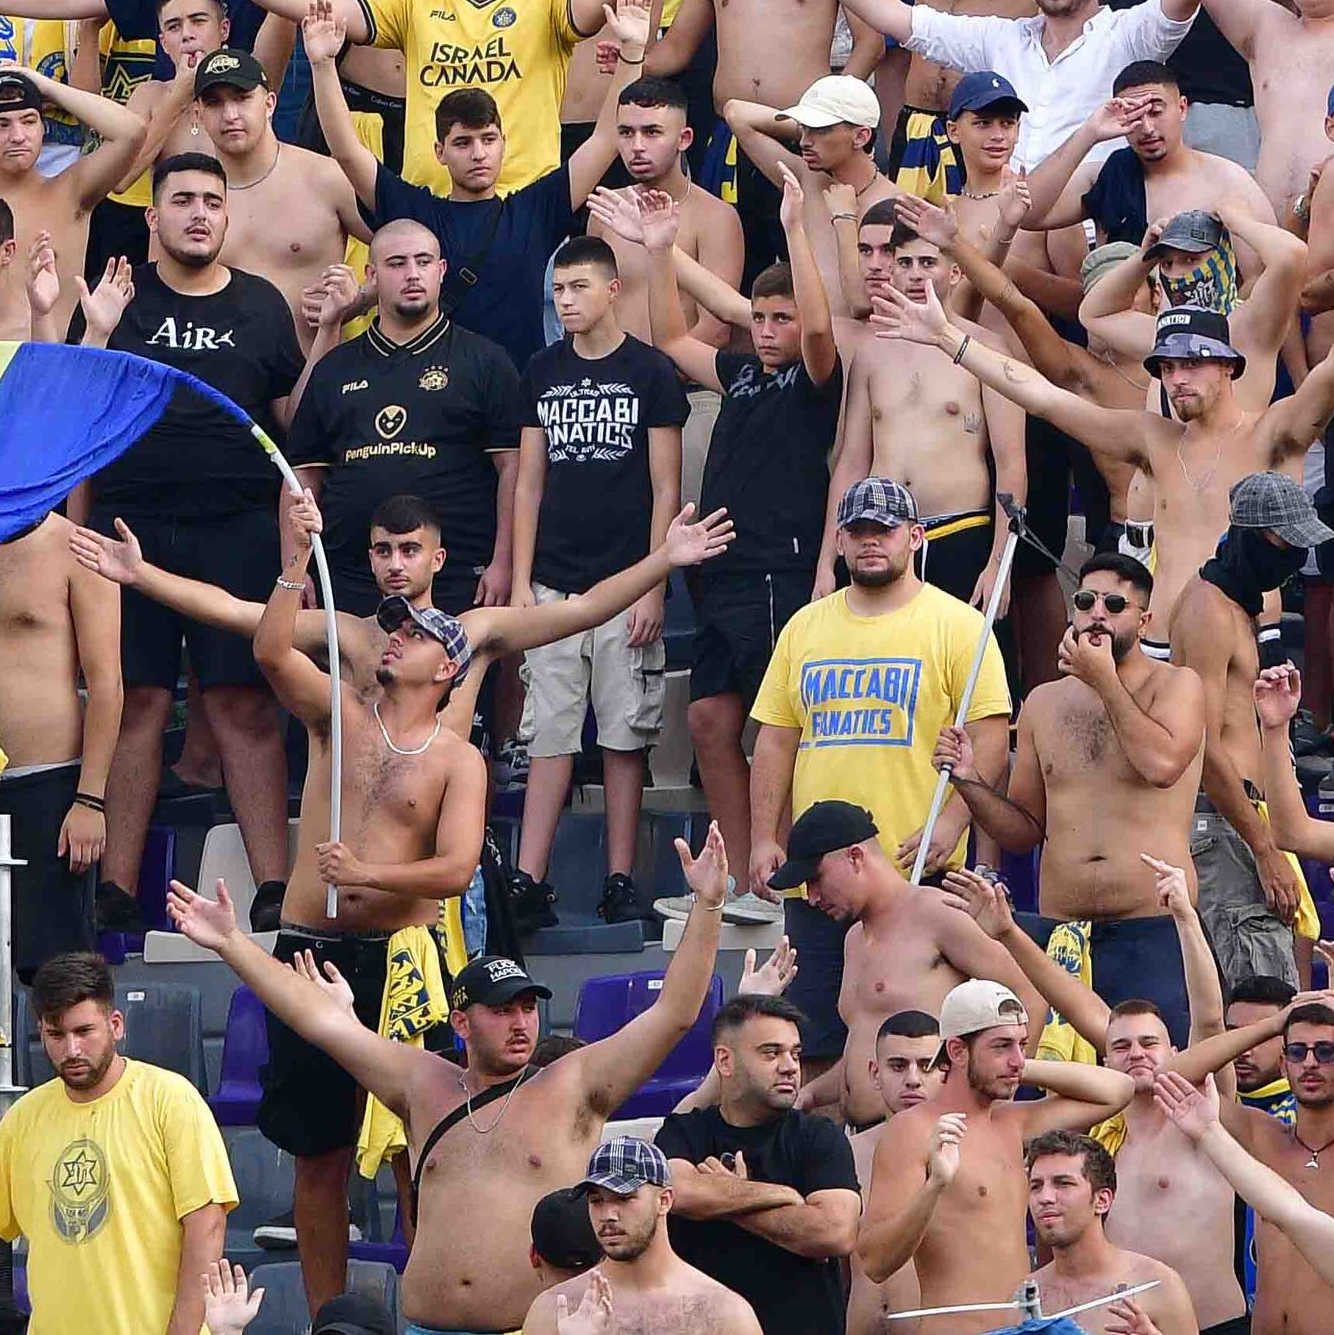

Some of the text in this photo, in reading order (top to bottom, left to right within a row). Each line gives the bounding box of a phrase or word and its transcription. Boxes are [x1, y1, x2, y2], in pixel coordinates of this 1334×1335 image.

[430, 10, 458, 22] FILA
[430, 37, 513, 65] ISRAEL
[419, 58, 526, 88] CANADA
[342, 380, 369, 395] FILA
[537, 397, 641, 428] MACCABI
[805, 667, 915, 709] MACCABI
[817, 709, 900, 735] FANATICS
